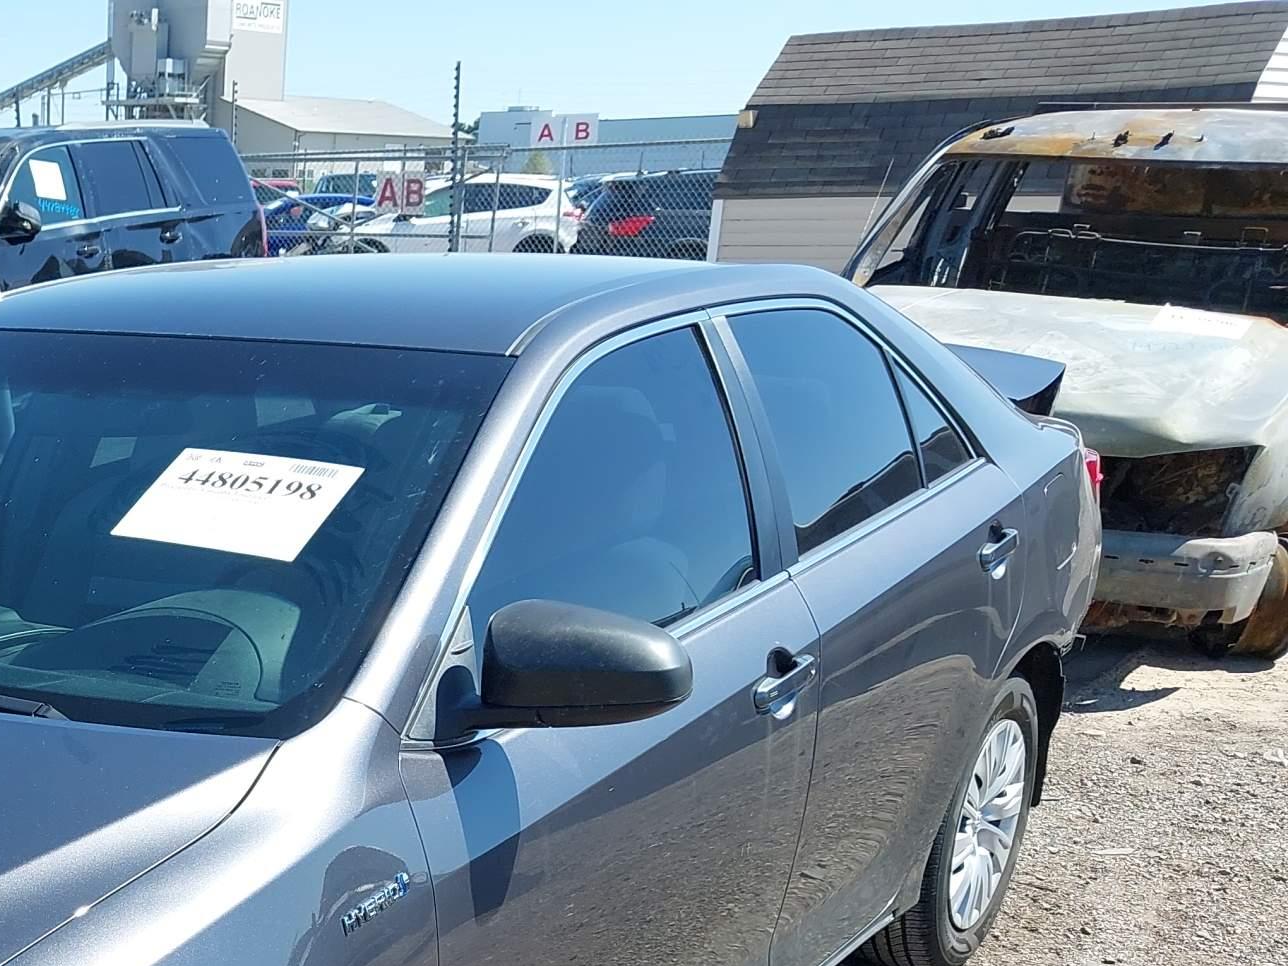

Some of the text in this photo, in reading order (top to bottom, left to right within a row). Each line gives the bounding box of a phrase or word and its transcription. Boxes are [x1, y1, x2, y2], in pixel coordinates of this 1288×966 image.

[235, 2, 281, 19] ROANOKE
[537, 121, 590, 142] A B
[377, 177, 424, 207] A B
[178, 468, 323, 501] 44805198
[341, 882, 400, 937] HYBRID
